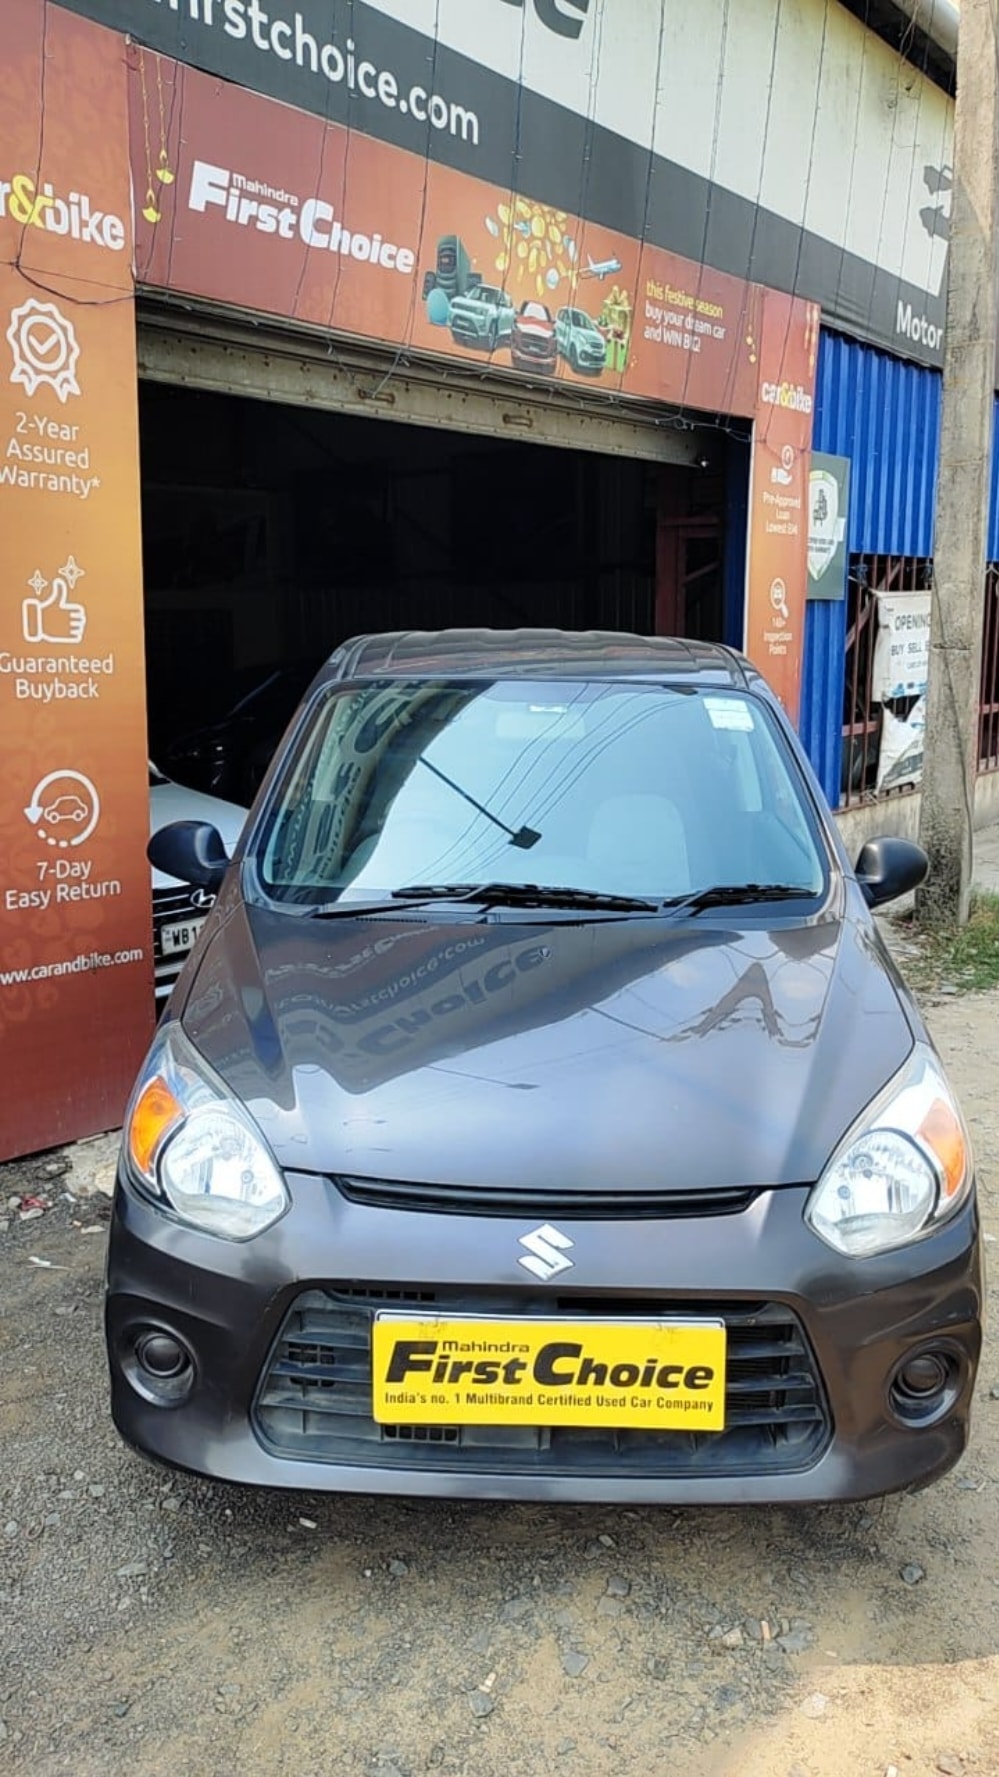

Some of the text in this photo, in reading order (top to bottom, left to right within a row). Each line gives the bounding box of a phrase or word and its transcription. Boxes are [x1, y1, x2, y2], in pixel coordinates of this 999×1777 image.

[153, 0, 479, 145] rstchoice.com
[232, 173, 299, 206] Mahindra
[188, 160, 415, 273] First Choice
[646, 280, 723, 320] this festive season
[645, 300, 727, 340] buy your dream car
[896, 299, 944, 350] Motor
[644, 326, 661, 342] and
[663, 326, 682, 348] WIN
[761, 381, 813, 414] car&bike
[15, 411, 79, 441] 2-Year
[6, 437, 89, 469] Assured
[0, 652, 113, 674] Guaranteed
[15, 677, 99, 703] Buyback
[36, 860, 92, 881] 7-Day
[5, 880, 121, 910] Easy Return
[441, 1341, 530, 1353] Mahindra
[385, 1340, 714, 1389] First Choice
[385, 1391, 714, 1412] India's no. 1 Multibrand Certified Used Car Company
